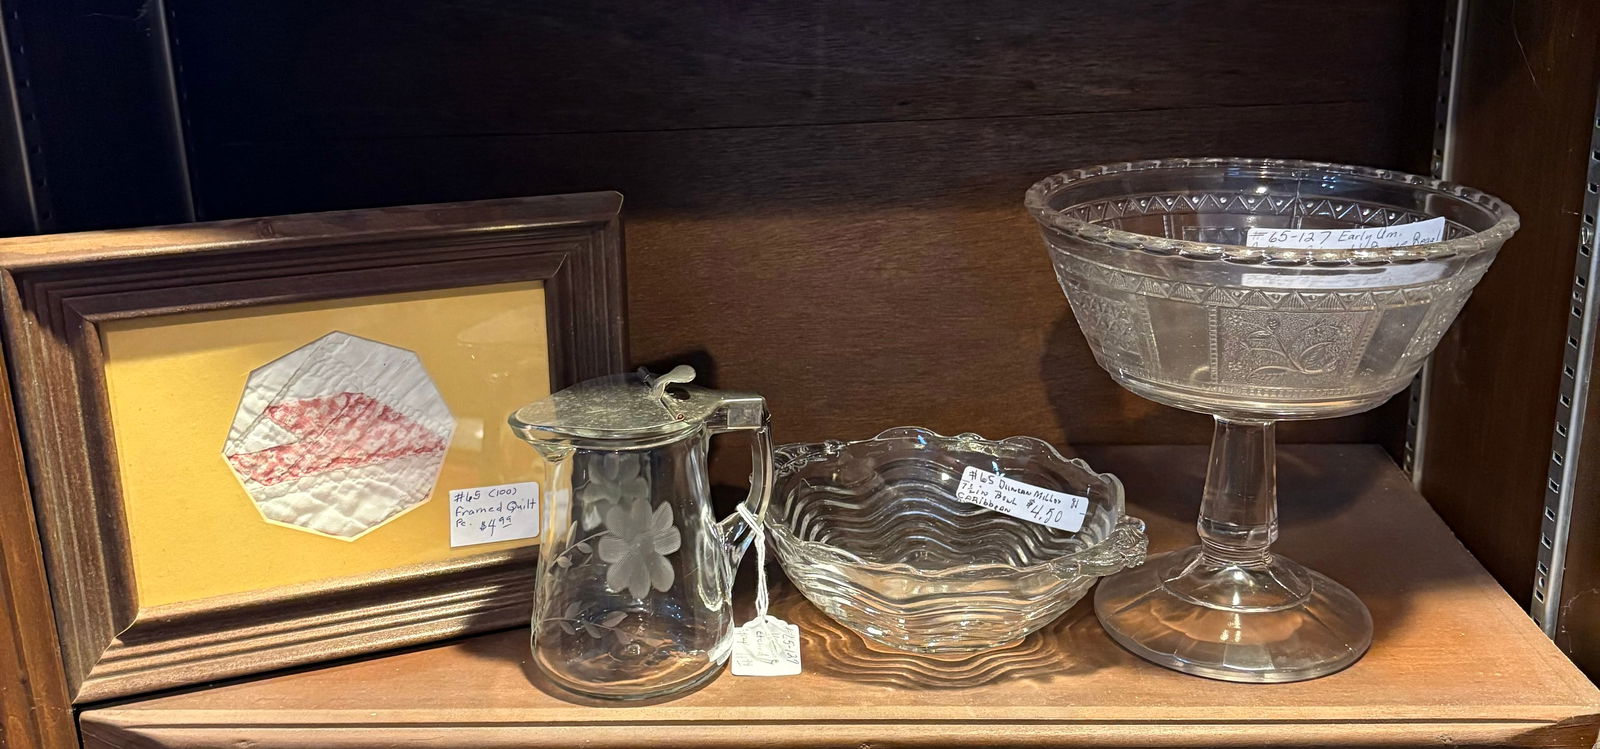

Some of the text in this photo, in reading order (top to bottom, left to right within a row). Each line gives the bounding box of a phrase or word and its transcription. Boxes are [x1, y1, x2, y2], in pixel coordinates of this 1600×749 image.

[1338, 230, 1373, 246] Early
[968, 469, 996, 485] #65
[454, 487, 518, 503] #65 (100)
[455, 498, 537, 517] Framed Quilt
[1026, 499, 1063, 524] $4.50
